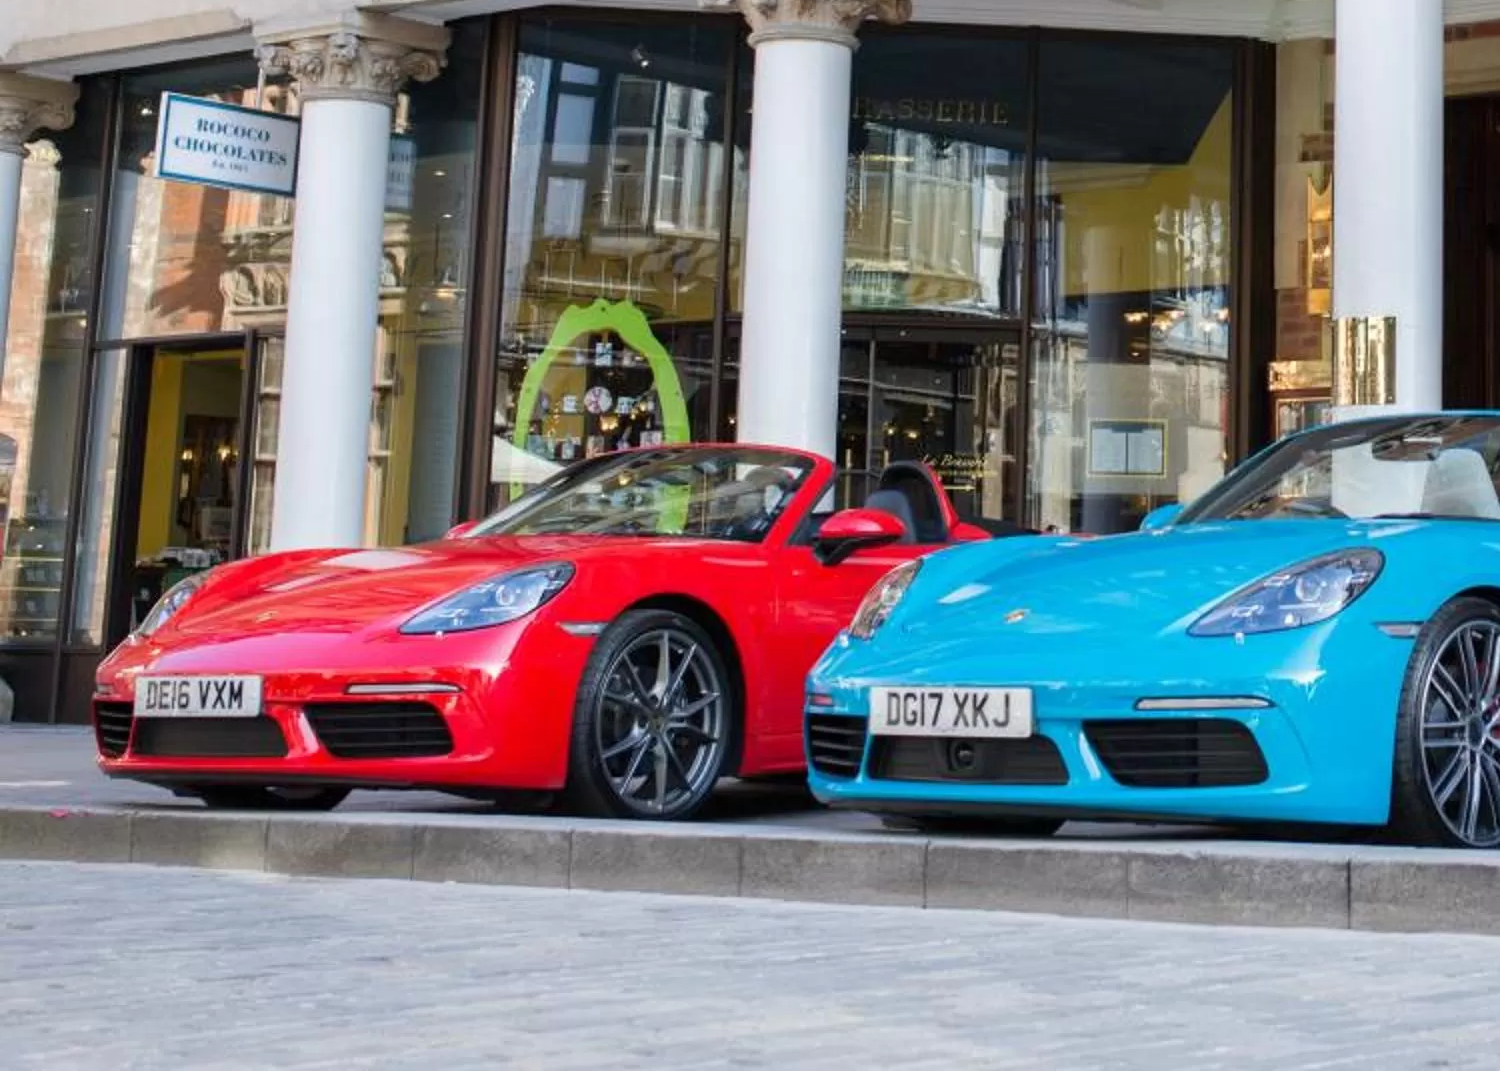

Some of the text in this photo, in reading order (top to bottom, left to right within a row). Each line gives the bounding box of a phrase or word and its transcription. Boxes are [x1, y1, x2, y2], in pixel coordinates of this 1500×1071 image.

[852, 96, 1009, 125] RASSERIE
[197, 118, 271, 142] ROCOCO
[174, 136, 288, 166] CHOCOLATES
[146, 680, 244, 710] DE16 VXM
[886, 692, 1011, 728] DG17 XKJ
